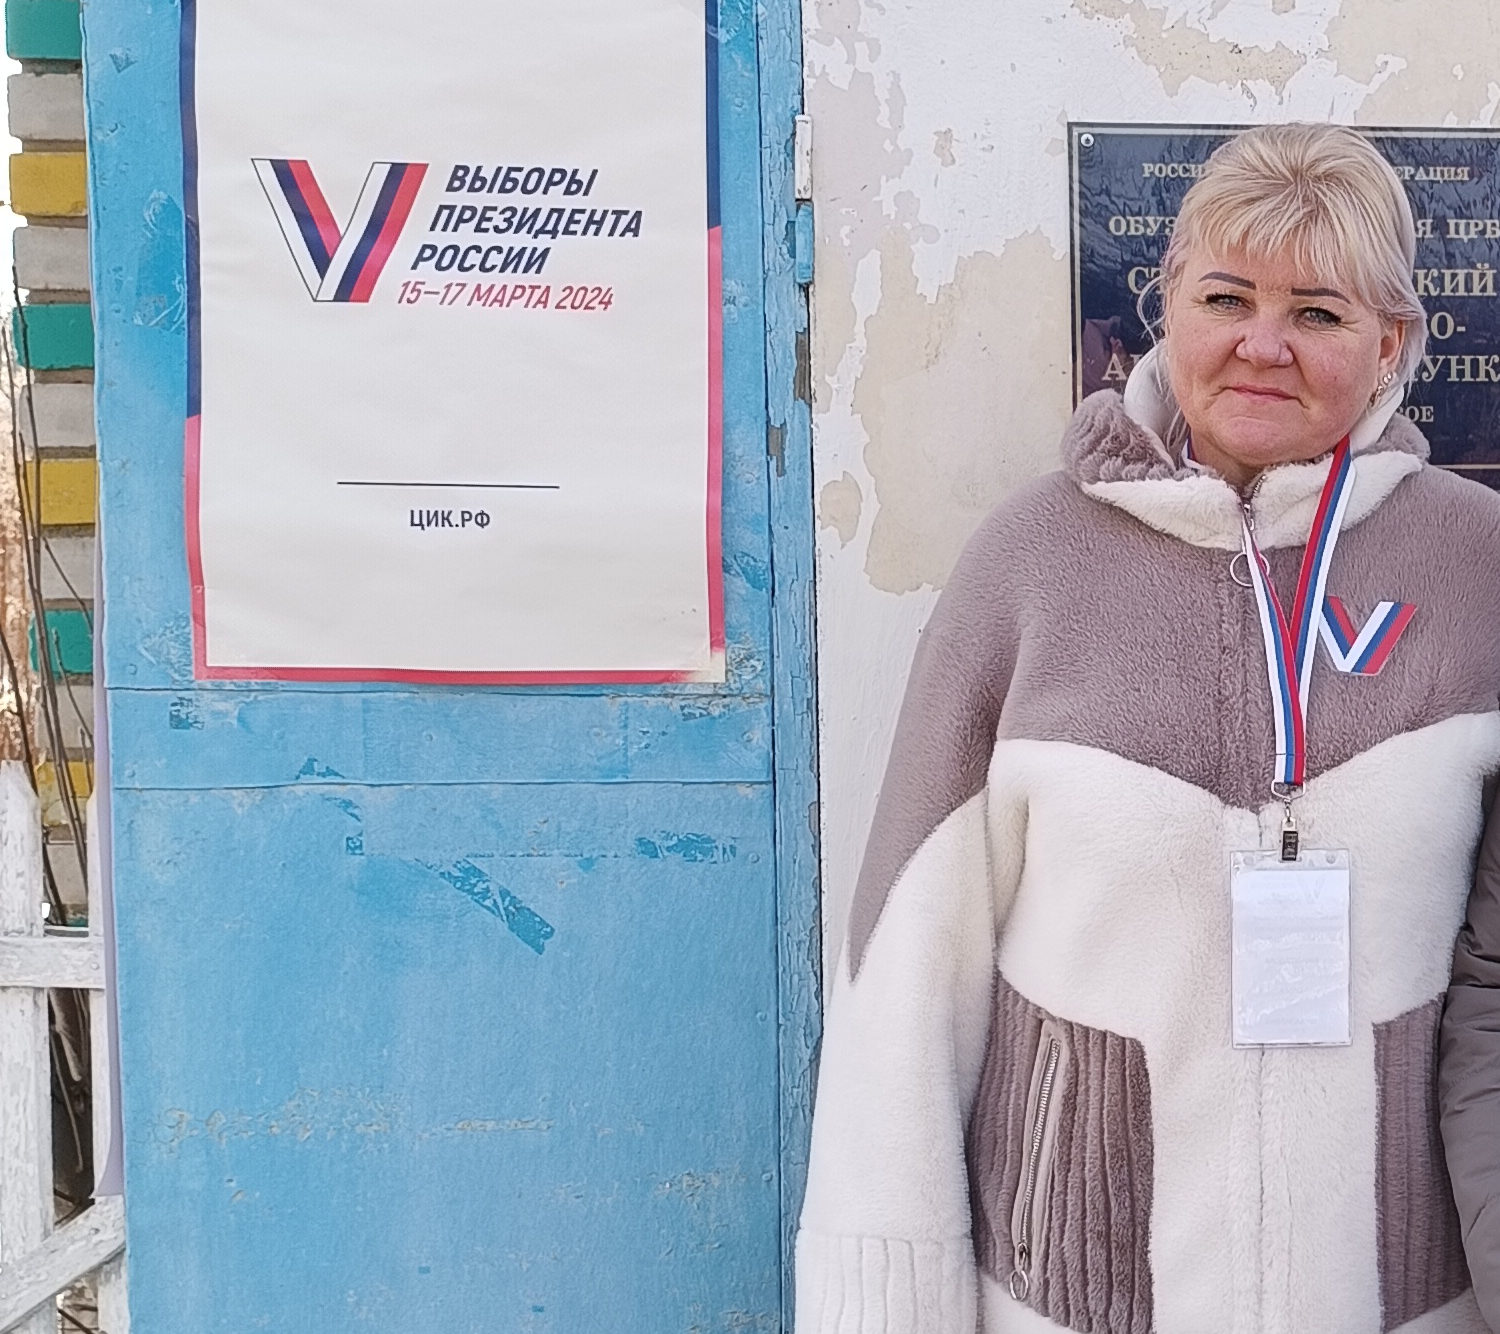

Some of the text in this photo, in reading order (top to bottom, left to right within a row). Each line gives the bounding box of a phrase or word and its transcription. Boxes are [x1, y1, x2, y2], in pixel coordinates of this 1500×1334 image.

[445, 164, 599, 197] ВЫБОРЫ
[428, 204, 643, 240] ПРЕЗИДЕНТА
[410, 243, 552, 275] РОССИИ
[467, 282, 551, 310] МАРТА
[554, 285, 615, 311] 2024
[409, 508, 491, 531] ЦИК.РФ
